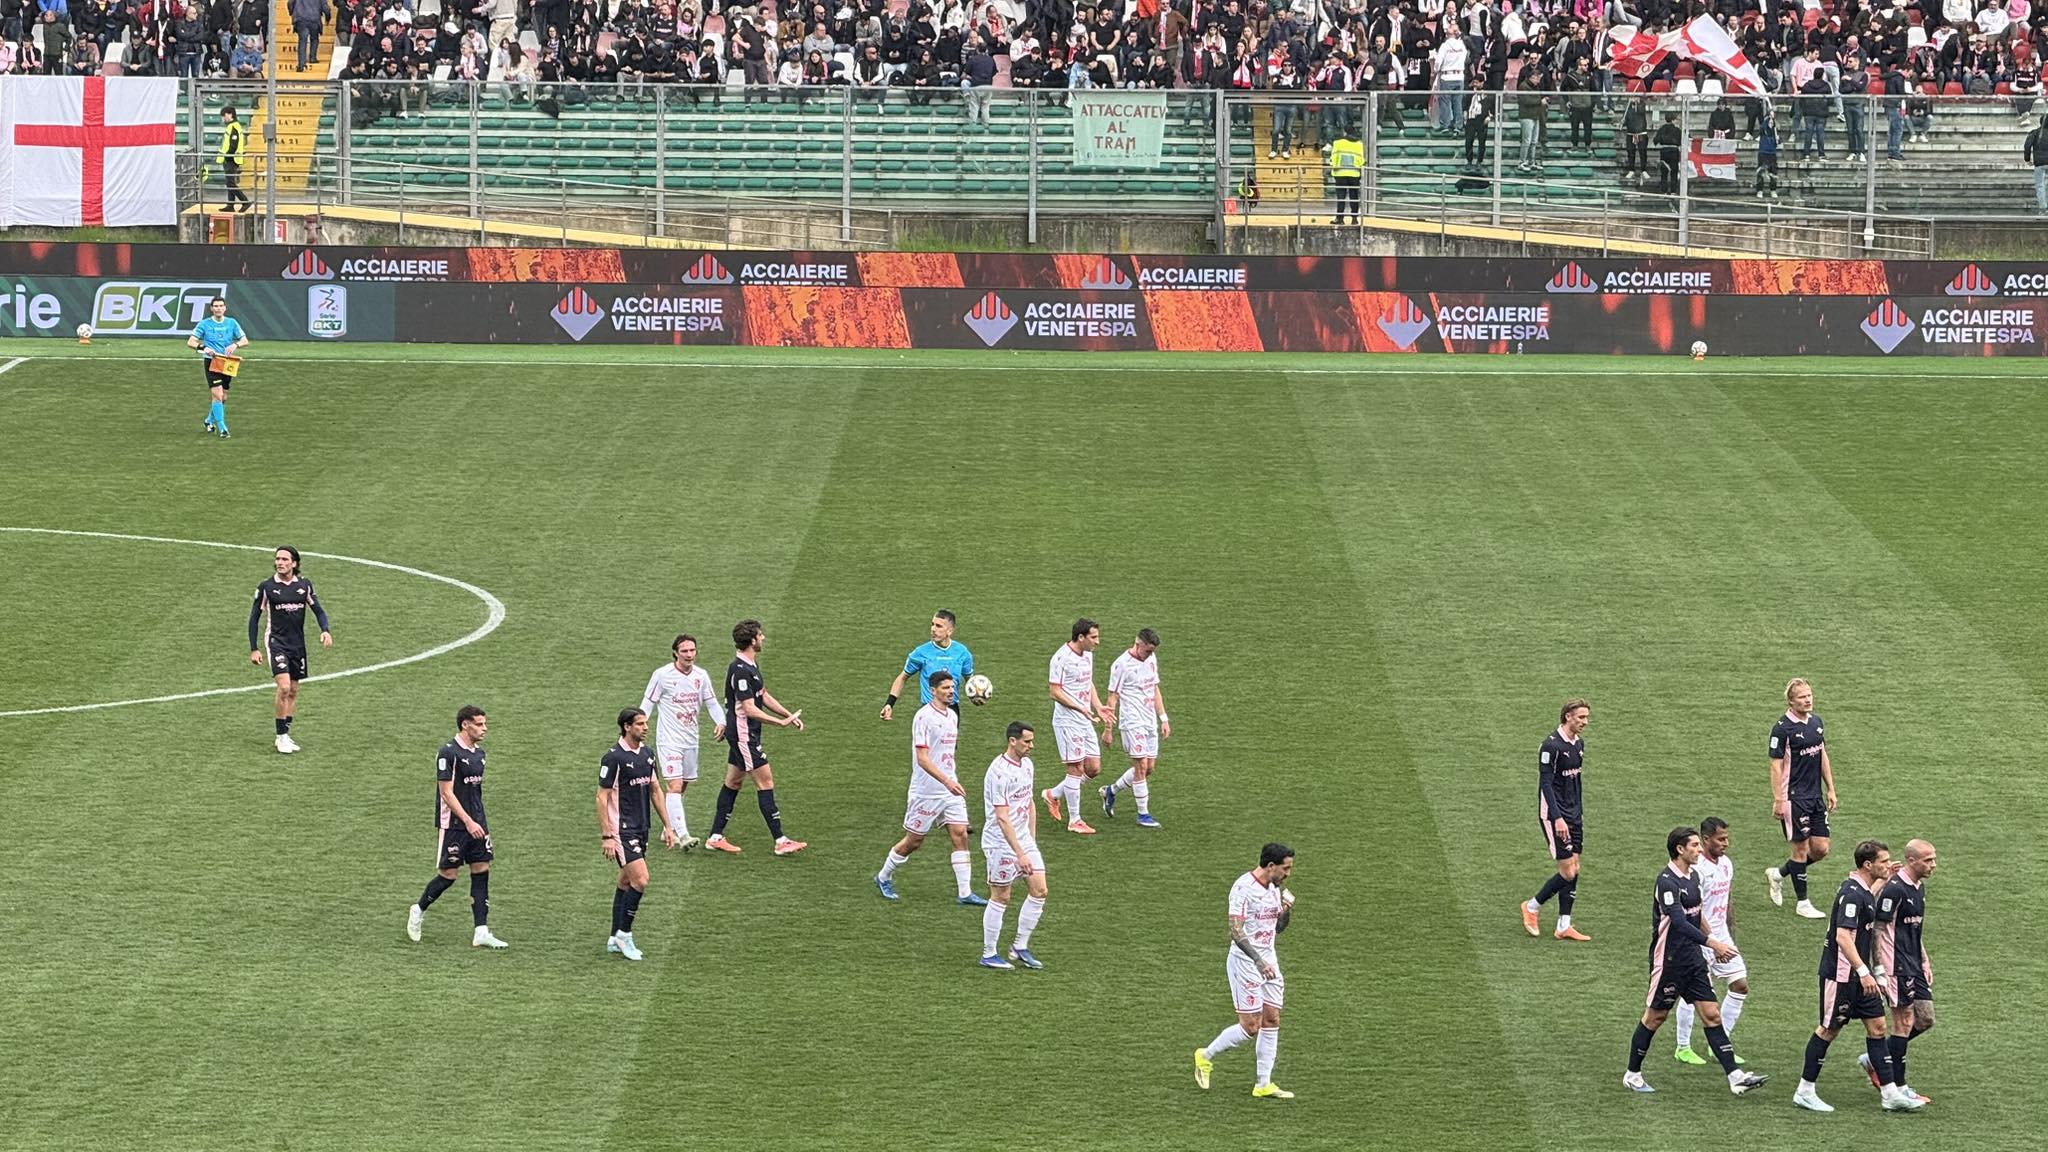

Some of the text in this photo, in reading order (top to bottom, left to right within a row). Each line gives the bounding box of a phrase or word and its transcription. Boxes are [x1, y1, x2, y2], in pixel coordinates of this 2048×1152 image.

[1094, 136, 1136, 153] TRAM
[341, 259, 448, 275] ACCIAIERIE
[741, 263, 847, 279] ACCIAIERIE
[1138, 268, 1246, 284] ACCIAIERIE
[1603, 271, 1712, 287] ACCIAIERIE
[100, 294, 214, 323] BKT
[611, 297, 723, 314] ACCIAIERIE
[1025, 303, 1135, 319] ACCIAIERIE
[1438, 306, 1549, 322] ACCIAIERIE
[1921, 309, 2034, 326] ACCIAIERIE
